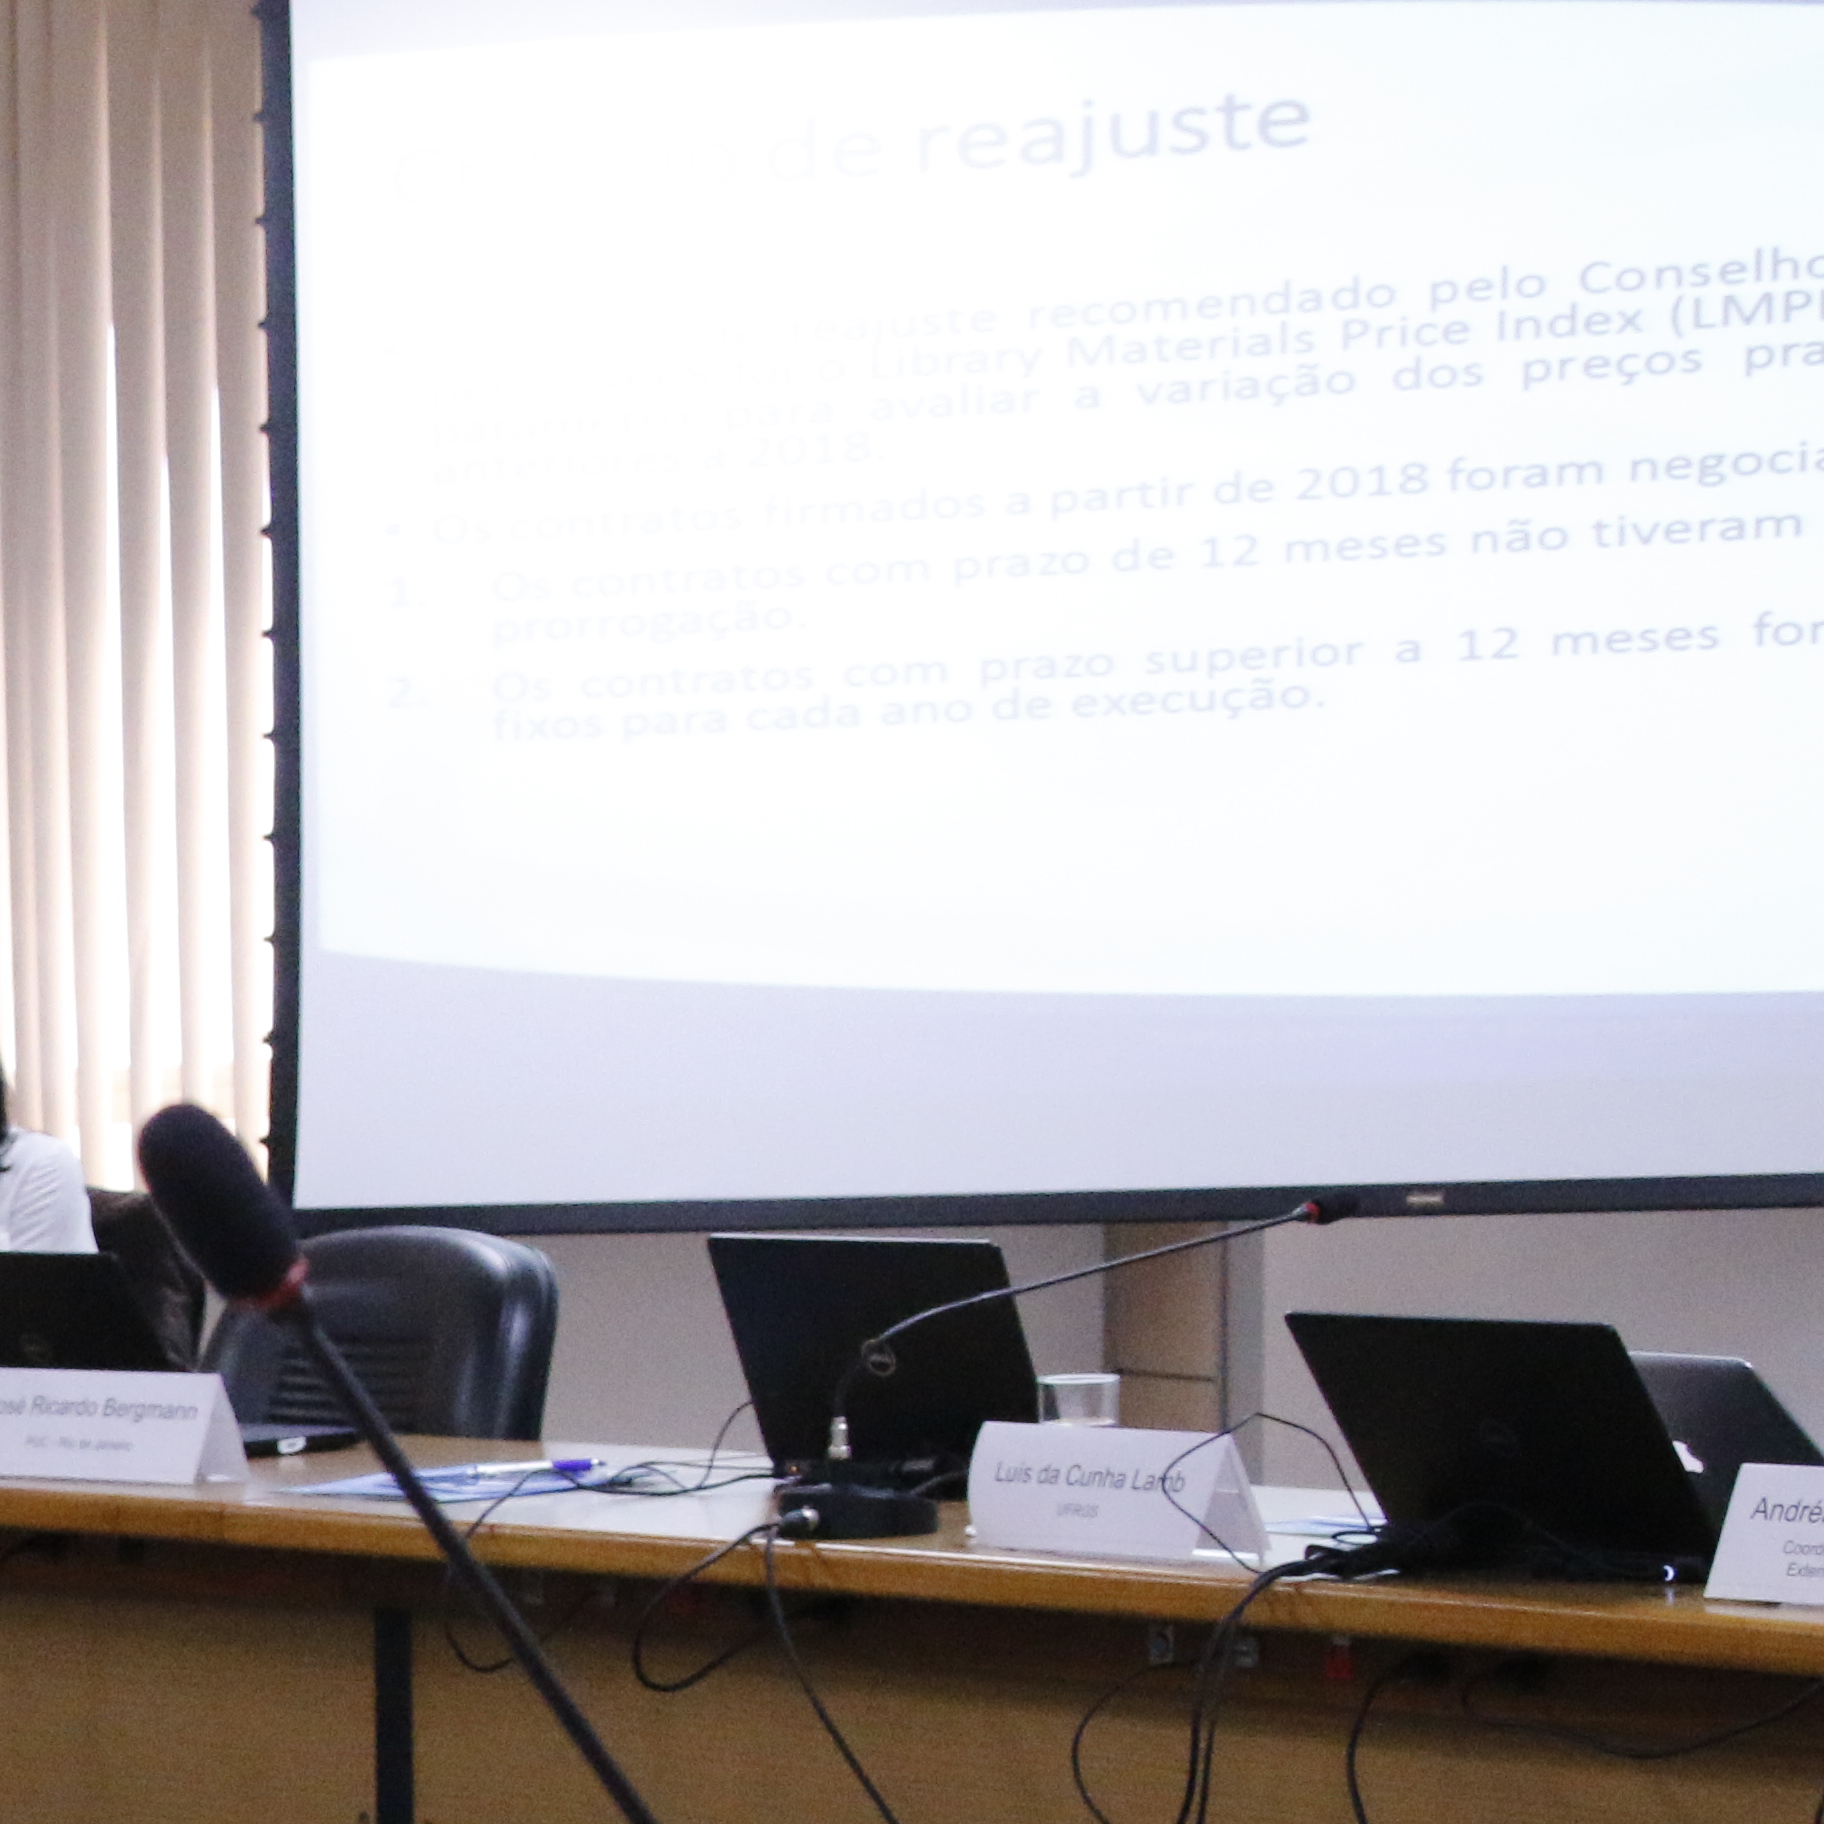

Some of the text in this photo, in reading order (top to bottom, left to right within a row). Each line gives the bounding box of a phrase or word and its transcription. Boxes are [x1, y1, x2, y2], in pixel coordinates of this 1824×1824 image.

[916, 92, 1313, 179] reajuste
[1028, 275, 1399, 331] recomendado
[1428, 264, 1547, 313] pelo
[1578, 245, 1824, 295] Conselho
[868, 383, 1042, 422] avaliar
[1074, 380, 1101, 410] a
[1136, 358, 1358, 408] variação
[1393, 354, 1485, 393] dos
[1521, 342, 1704, 393] preços
[869, 343, 1044, 383] Library
[1066, 320, 1317, 370] Materials
[1340, 312, 1472, 352] Price
[1497, 301, 1646, 343] Index
[763, 486, 987, 527] firmados
[1003, 489, 1033, 516] a
[1048, 477, 1194, 519] partir
[1211, 469, 1277, 508] de
[1294, 460, 1432, 503] 2018
[1447, 455, 1606, 494] foram
[491, 570, 552, 604] Os
[570, 561, 806, 599] contratos
[825, 553, 933, 590] com
[954, 548, 1091, 589] prazo
[1110, 535, 1176, 575] de
[1200, 533, 1261, 570] 12
[1284, 526, 1449, 565] meses
[1471, 516, 1571, 556] não
[1592, 509, 1806, 551] tiveram
[491, 669, 554, 704] Os
[579, 661, 816, 700] contratos
[842, 654, 950, 690] com
[978, 647, 1116, 690] prazo
[1145, 636, 1367, 679] superior
[1393, 636, 1425, 666] a
[1456, 626, 1521, 664] 12
[1550, 620, 1723, 658] meses
[491, 677, 1327, 744] fixos para cada ano de execução.
[30, 1395, 99, 1418] Ricardo
[102, 1397, 199, 1423] Bergmann
[1037, 1463, 1061, 1485] da
[1065, 1463, 1127, 1490] Cunha
[1750, 1496, 1824, 1524] André
